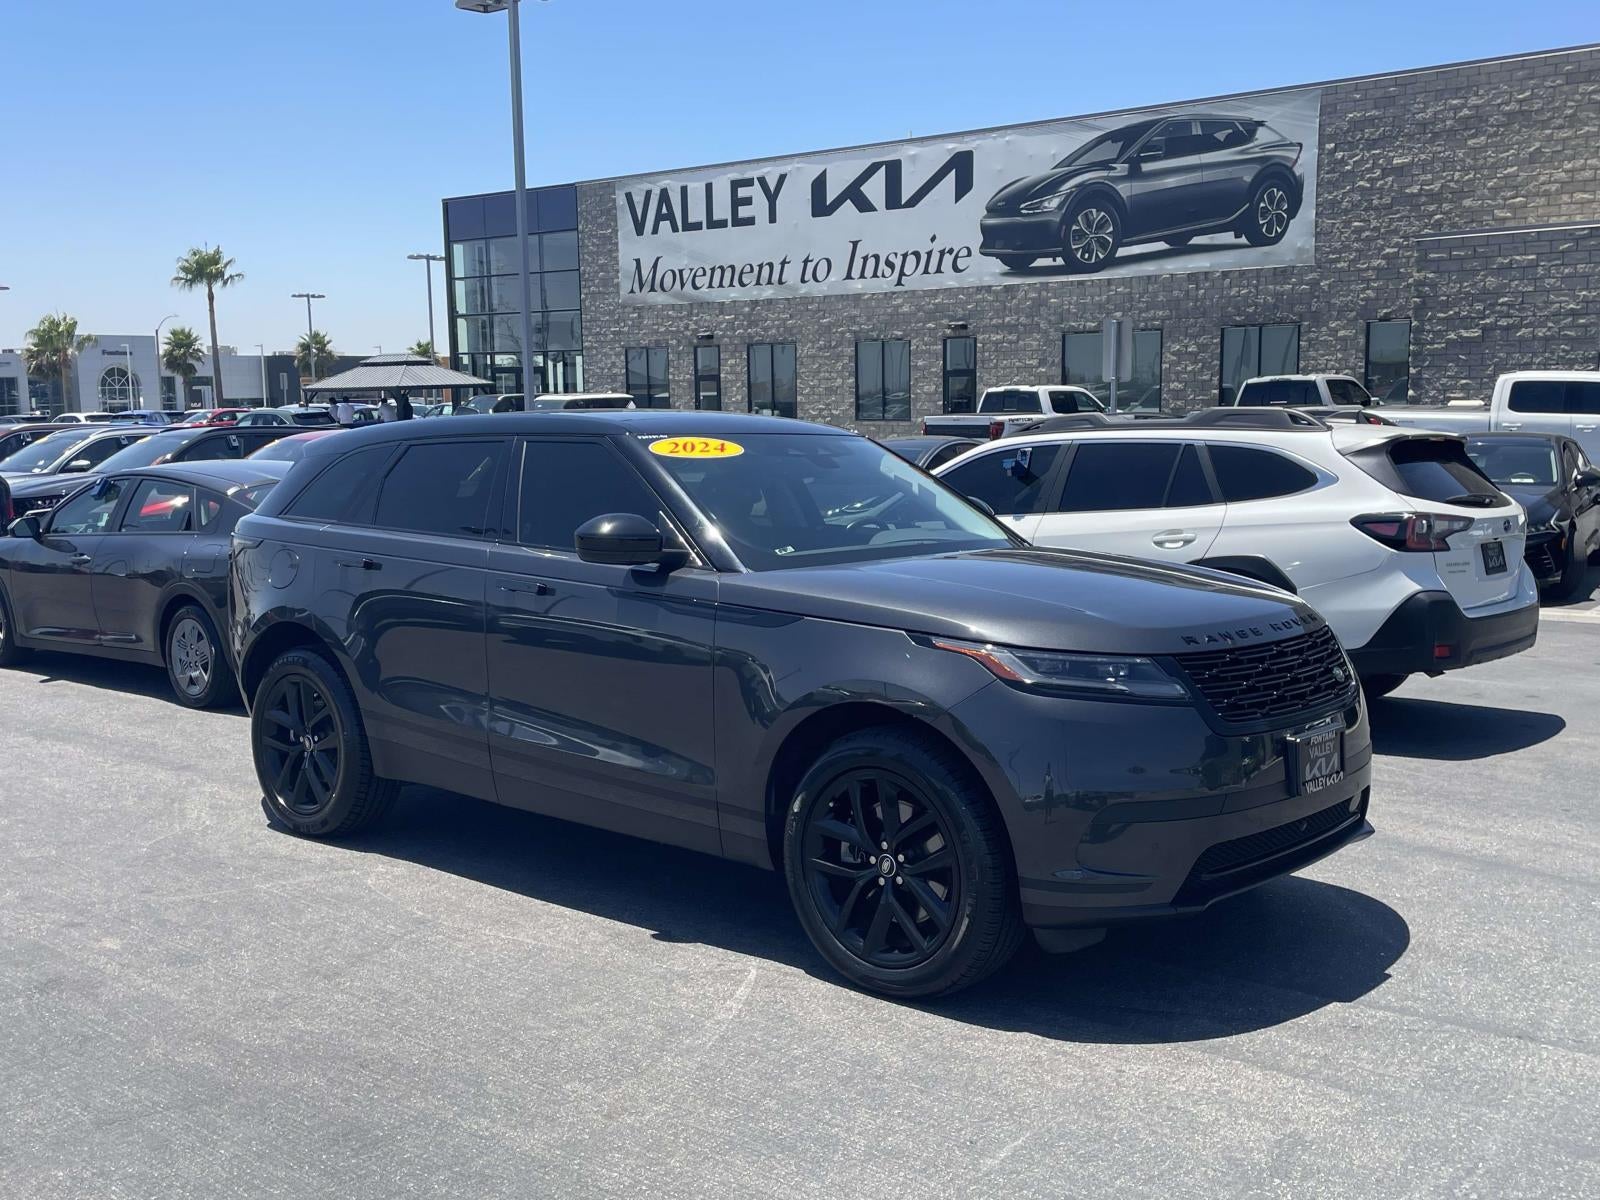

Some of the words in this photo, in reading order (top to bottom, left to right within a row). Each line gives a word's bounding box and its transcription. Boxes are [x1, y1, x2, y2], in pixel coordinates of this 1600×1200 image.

[625, 173, 787, 236] VALLEY
[811, 149, 974, 218] KIA
[628, 254, 791, 294] Movement
[800, 252, 832, 284] to
[843, 233, 972, 287] Inspire
[668, 441, 727, 454] 2024
[1181, 627, 1263, 646] RANGE
[1269, 613, 1318, 633] ROVER
[1309, 741, 1335, 759] VALLEY
[1311, 730, 1336, 746] FONTANA
[1305, 752, 1338, 780] KIA
[1305, 776, 1327, 794] VALLEY
[1327, 771, 1344, 787] KIA
